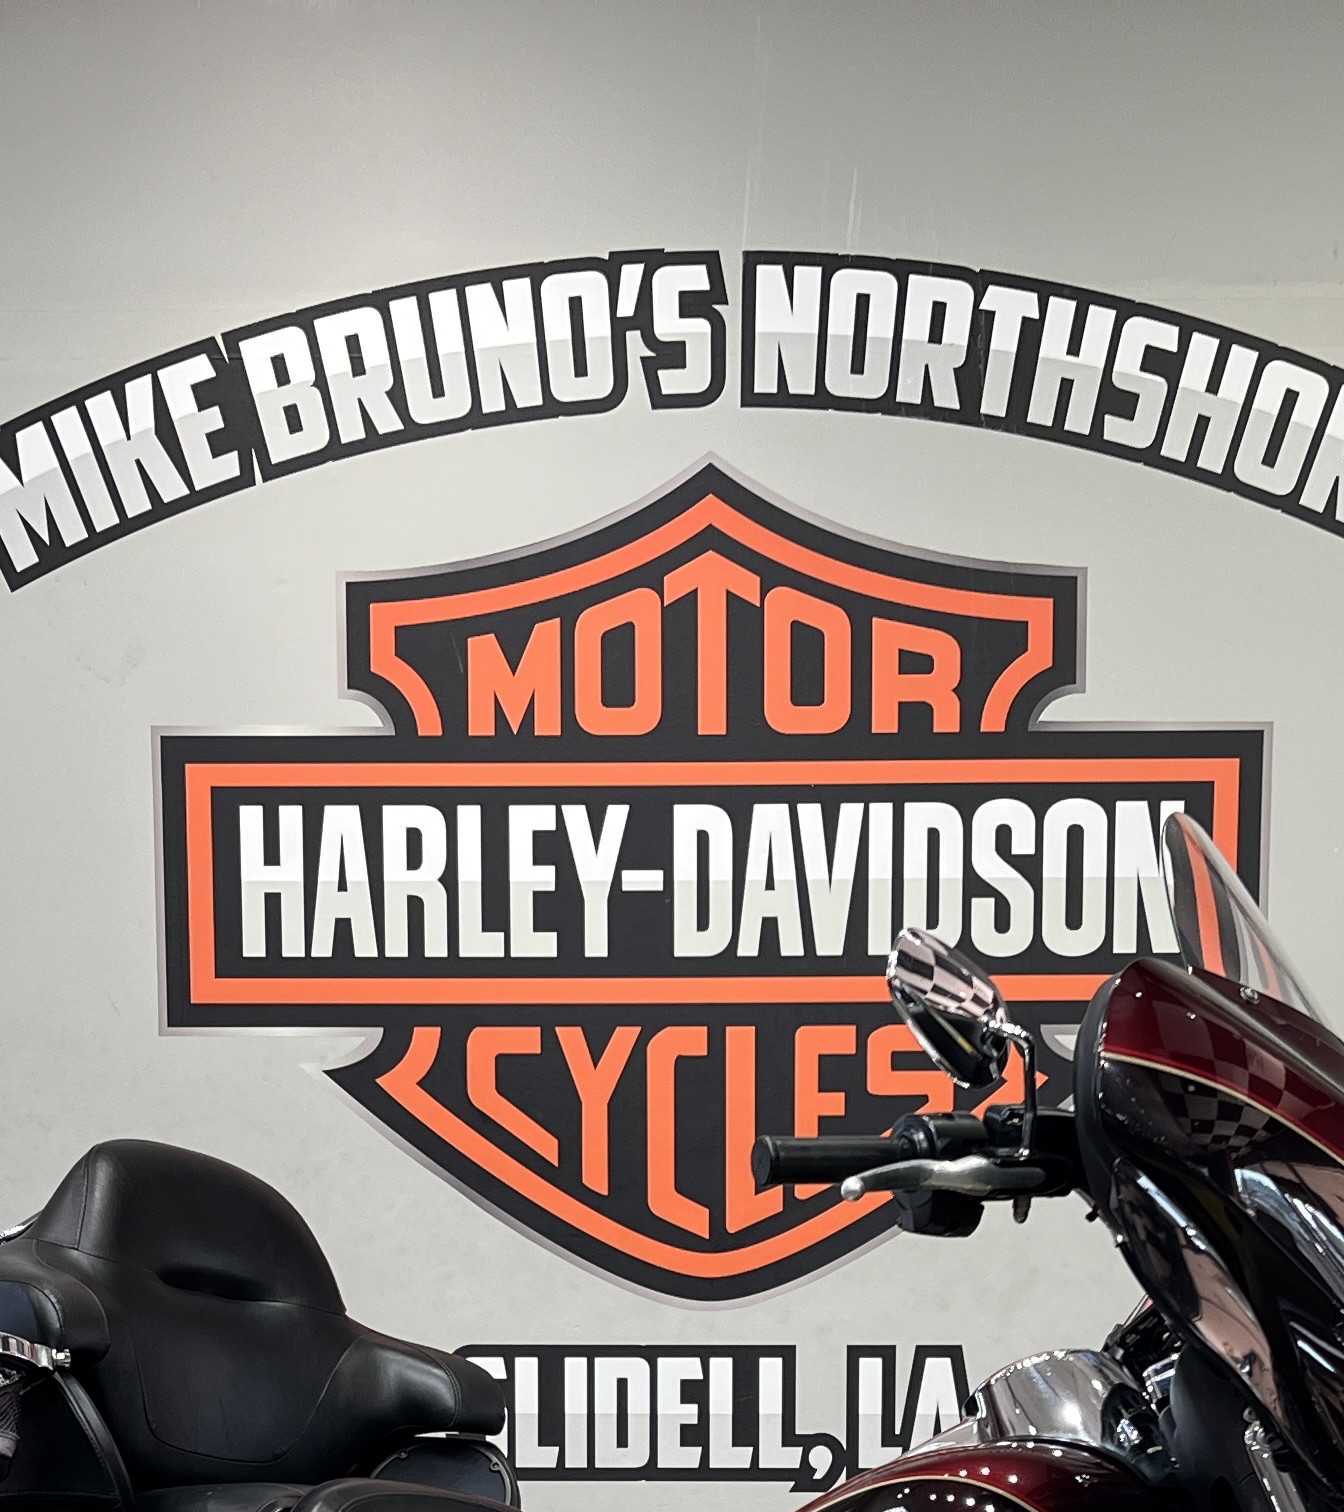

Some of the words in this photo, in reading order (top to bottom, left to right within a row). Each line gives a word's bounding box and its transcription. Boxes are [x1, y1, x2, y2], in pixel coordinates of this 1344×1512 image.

[236, 260, 716, 466] BRUNO'S
[465, 547, 963, 737] MOTOR
[236, 796, 1186, 961] HARLEY-DAVIDSON
[464, 1022, 956, 1240] CYCLES
[856, 1355, 966, 1470] LA
